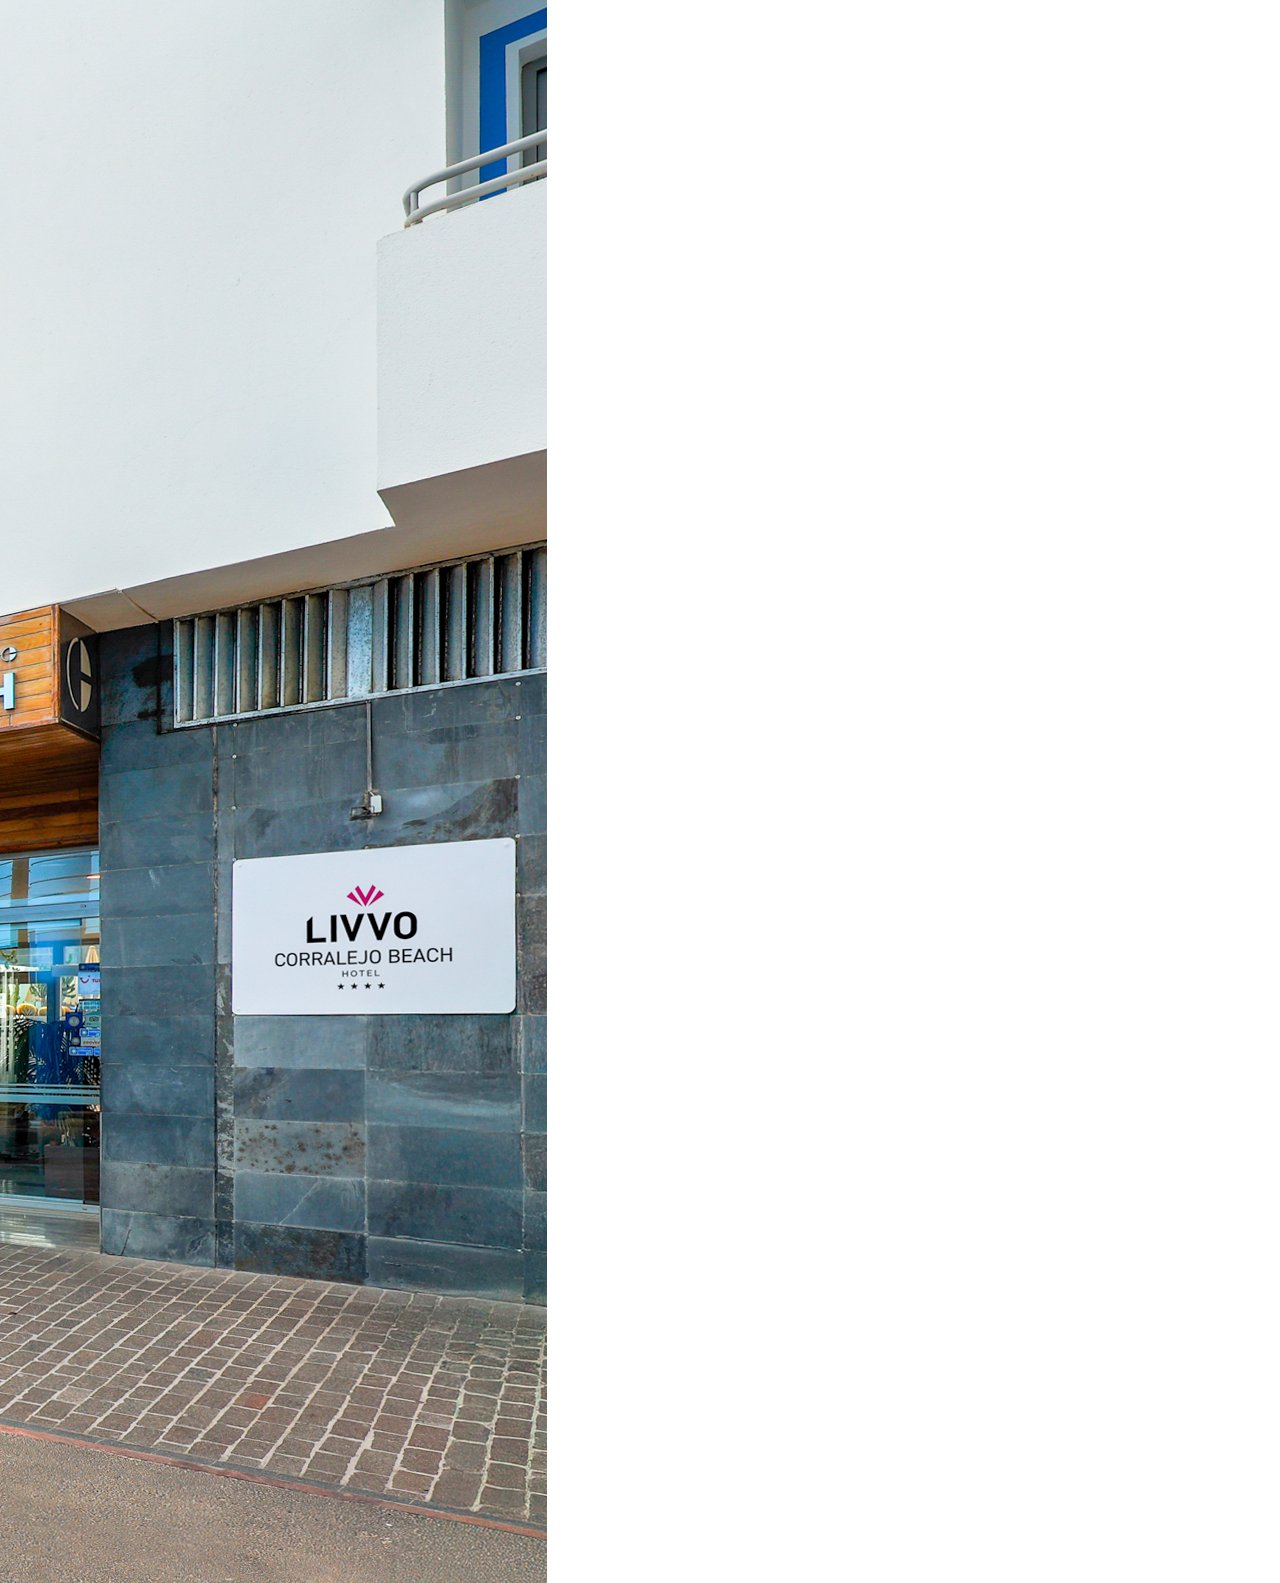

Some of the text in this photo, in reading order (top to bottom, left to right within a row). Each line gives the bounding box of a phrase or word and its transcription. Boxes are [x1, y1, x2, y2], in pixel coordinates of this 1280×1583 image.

[306, 911, 418, 944] LIVVO
[274, 947, 453, 967] CORRALEJO BEACH
[341, 969, 380, 977] HOTEL
